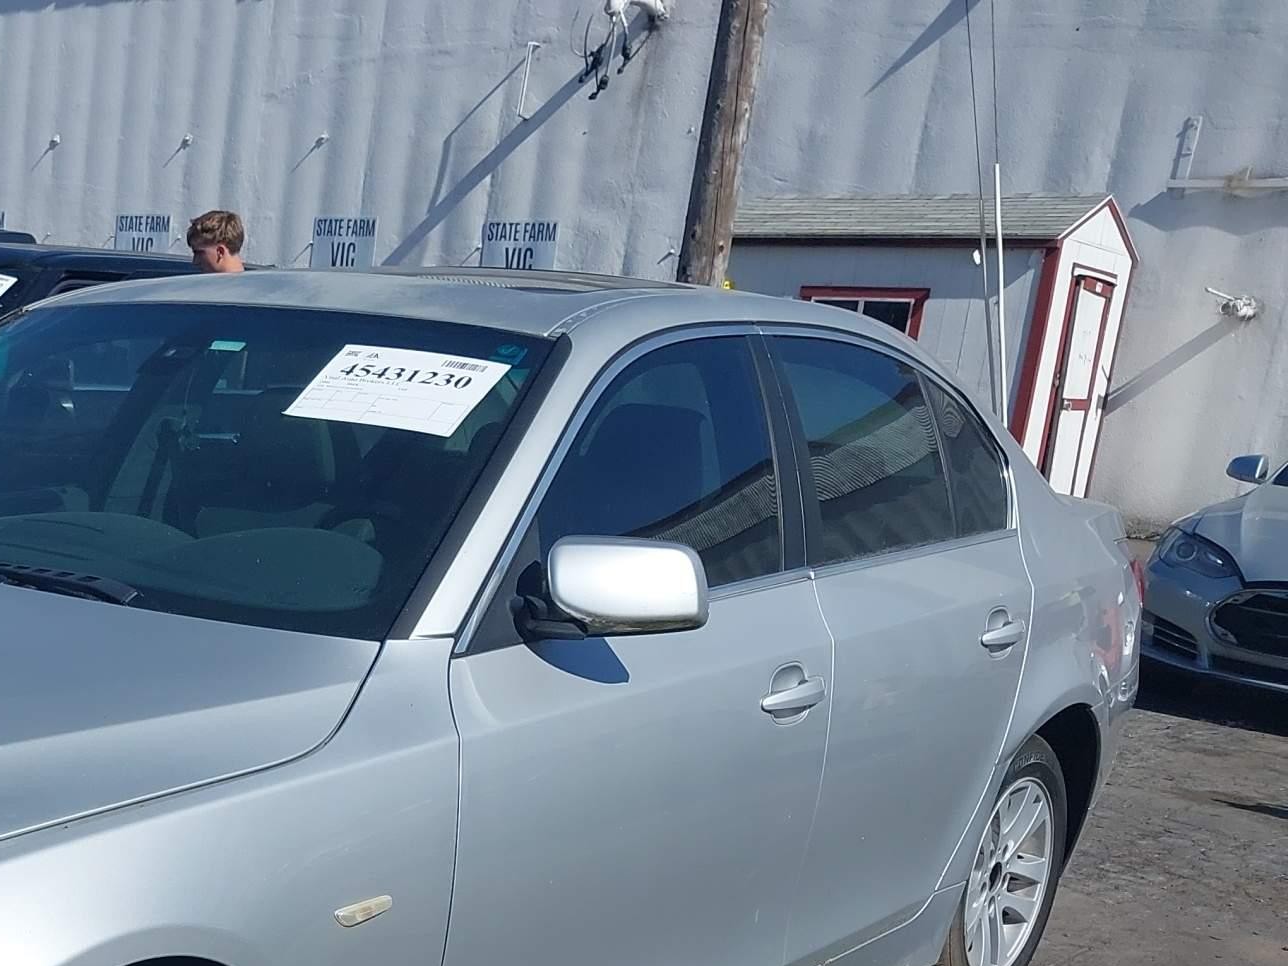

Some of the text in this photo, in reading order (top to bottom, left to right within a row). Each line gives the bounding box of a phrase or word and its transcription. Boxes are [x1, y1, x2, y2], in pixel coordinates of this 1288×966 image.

[119, 215, 170, 233] STATE FARM
[316, 218, 376, 238] STATE FARM
[487, 222, 557, 242] STATE FARM
[330, 242, 356, 267] VIC
[504, 247, 534, 270] VIC
[339, 362, 473, 390] 45431230
